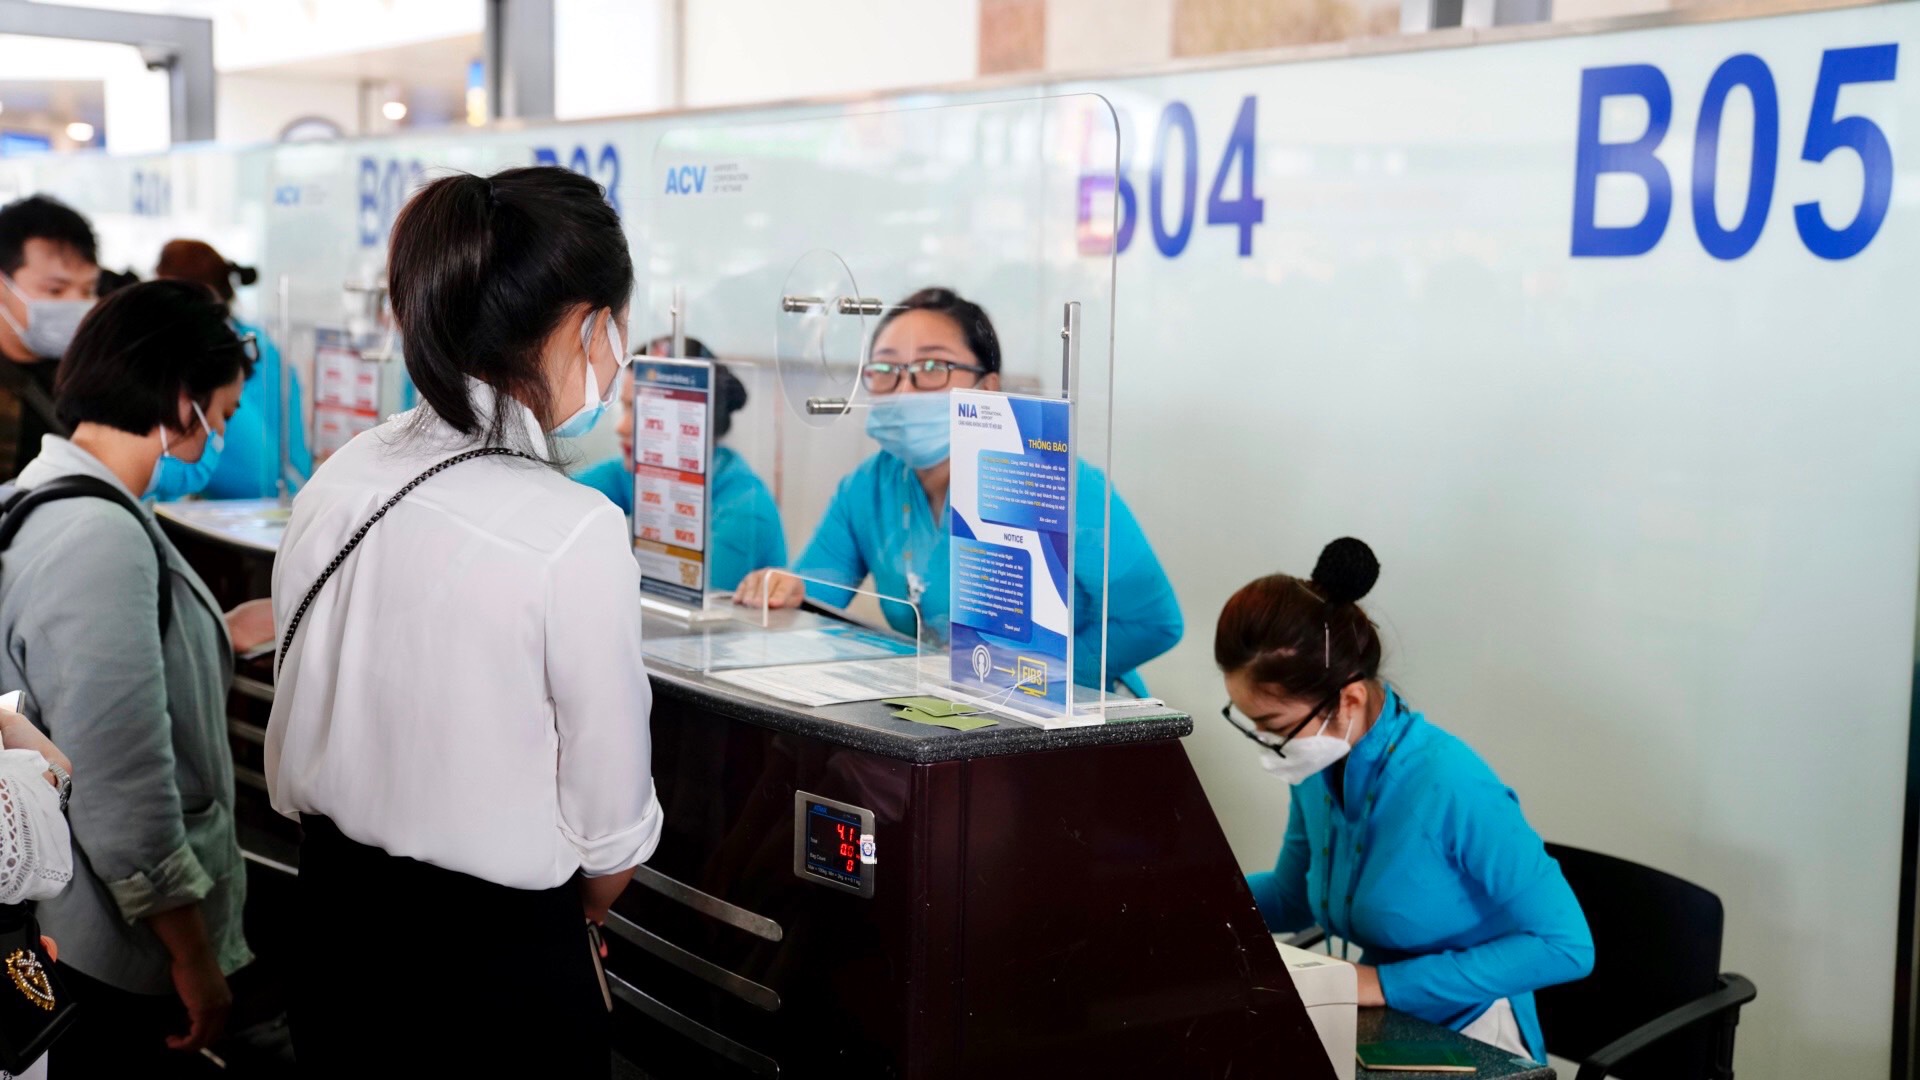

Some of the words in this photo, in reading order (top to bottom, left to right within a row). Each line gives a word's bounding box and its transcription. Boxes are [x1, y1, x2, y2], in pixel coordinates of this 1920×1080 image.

[1570, 42, 1900, 261] B05
[665, 165, 706, 194] ACV
[1077, 95, 1264, 258] B04
[958, 402, 978, 418] NIA
[1028, 438, 1051, 451] THÔNG
[1053, 440, 1067, 452] BÁO
[1004, 533, 1023, 544] NOTICE
